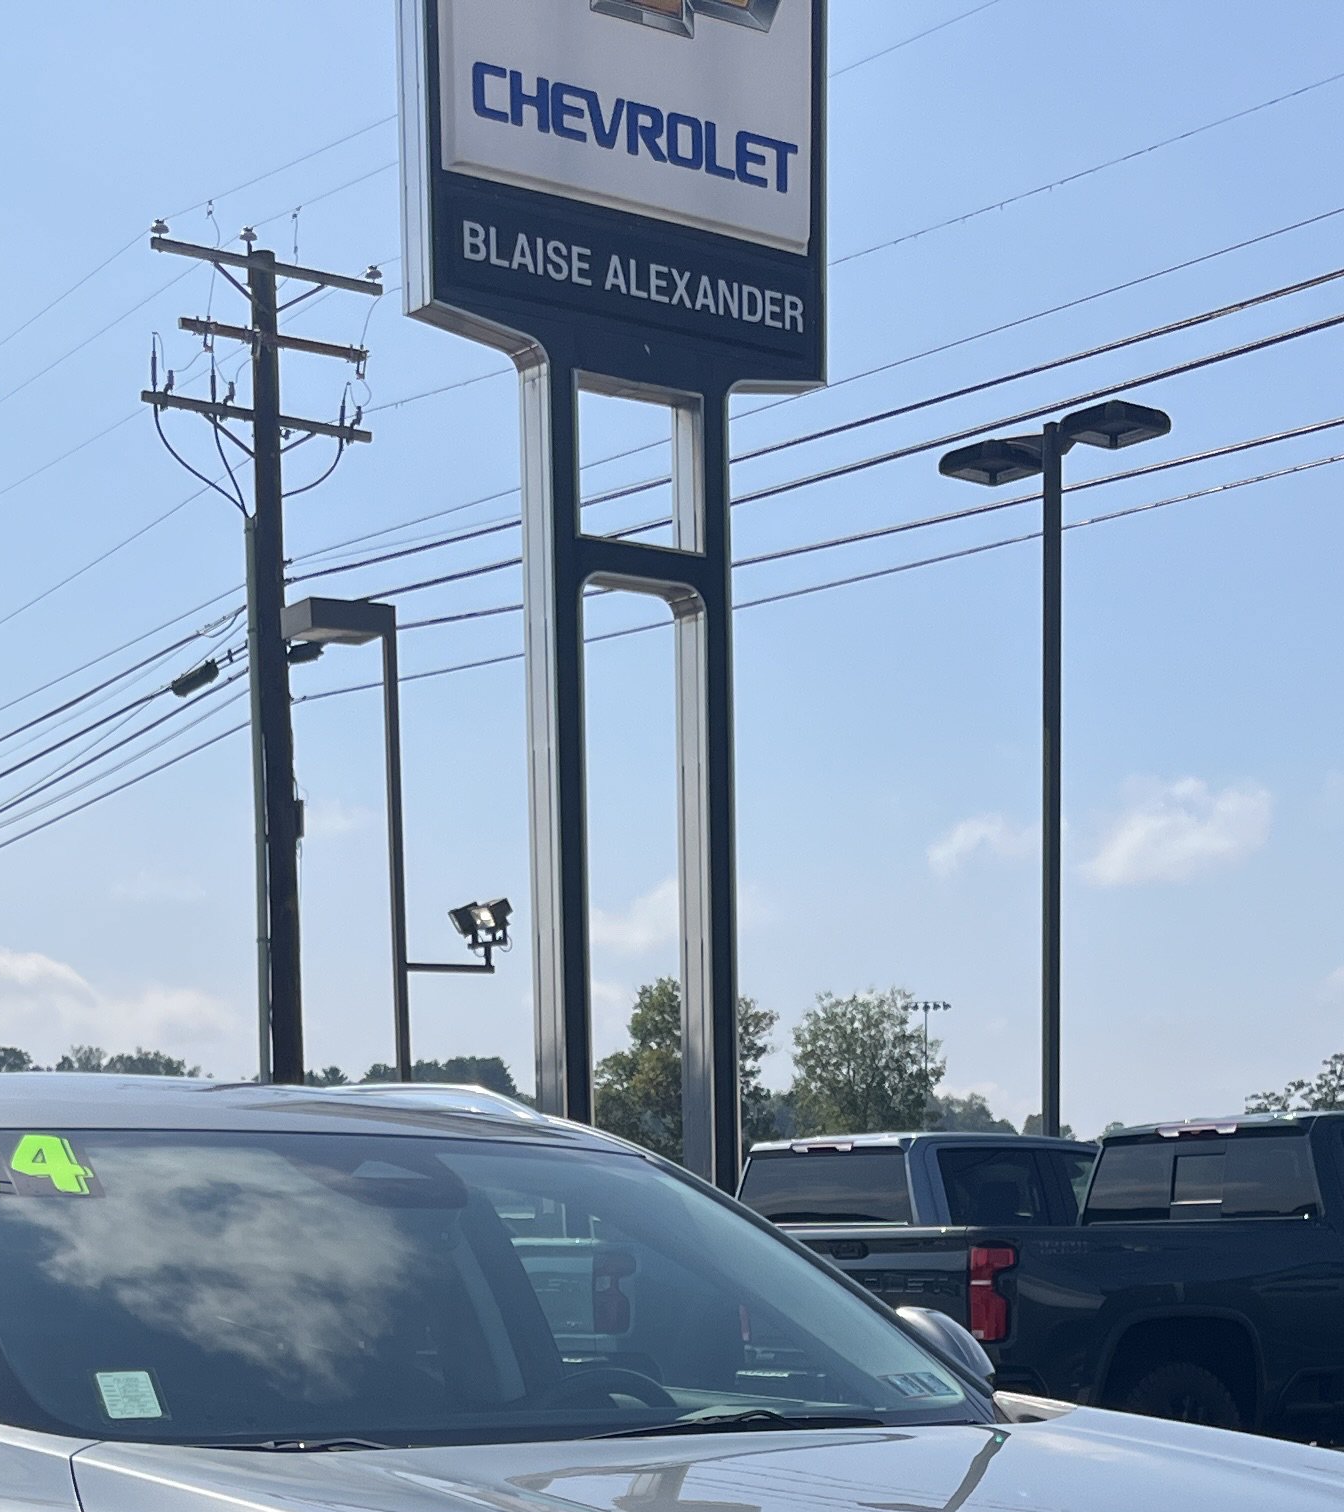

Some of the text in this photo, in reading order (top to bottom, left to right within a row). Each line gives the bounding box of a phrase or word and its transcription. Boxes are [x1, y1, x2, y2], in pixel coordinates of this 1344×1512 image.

[472, 61, 798, 194] CHEVROLET
[462, 219, 804, 333] BLAISE ALEXANDER
